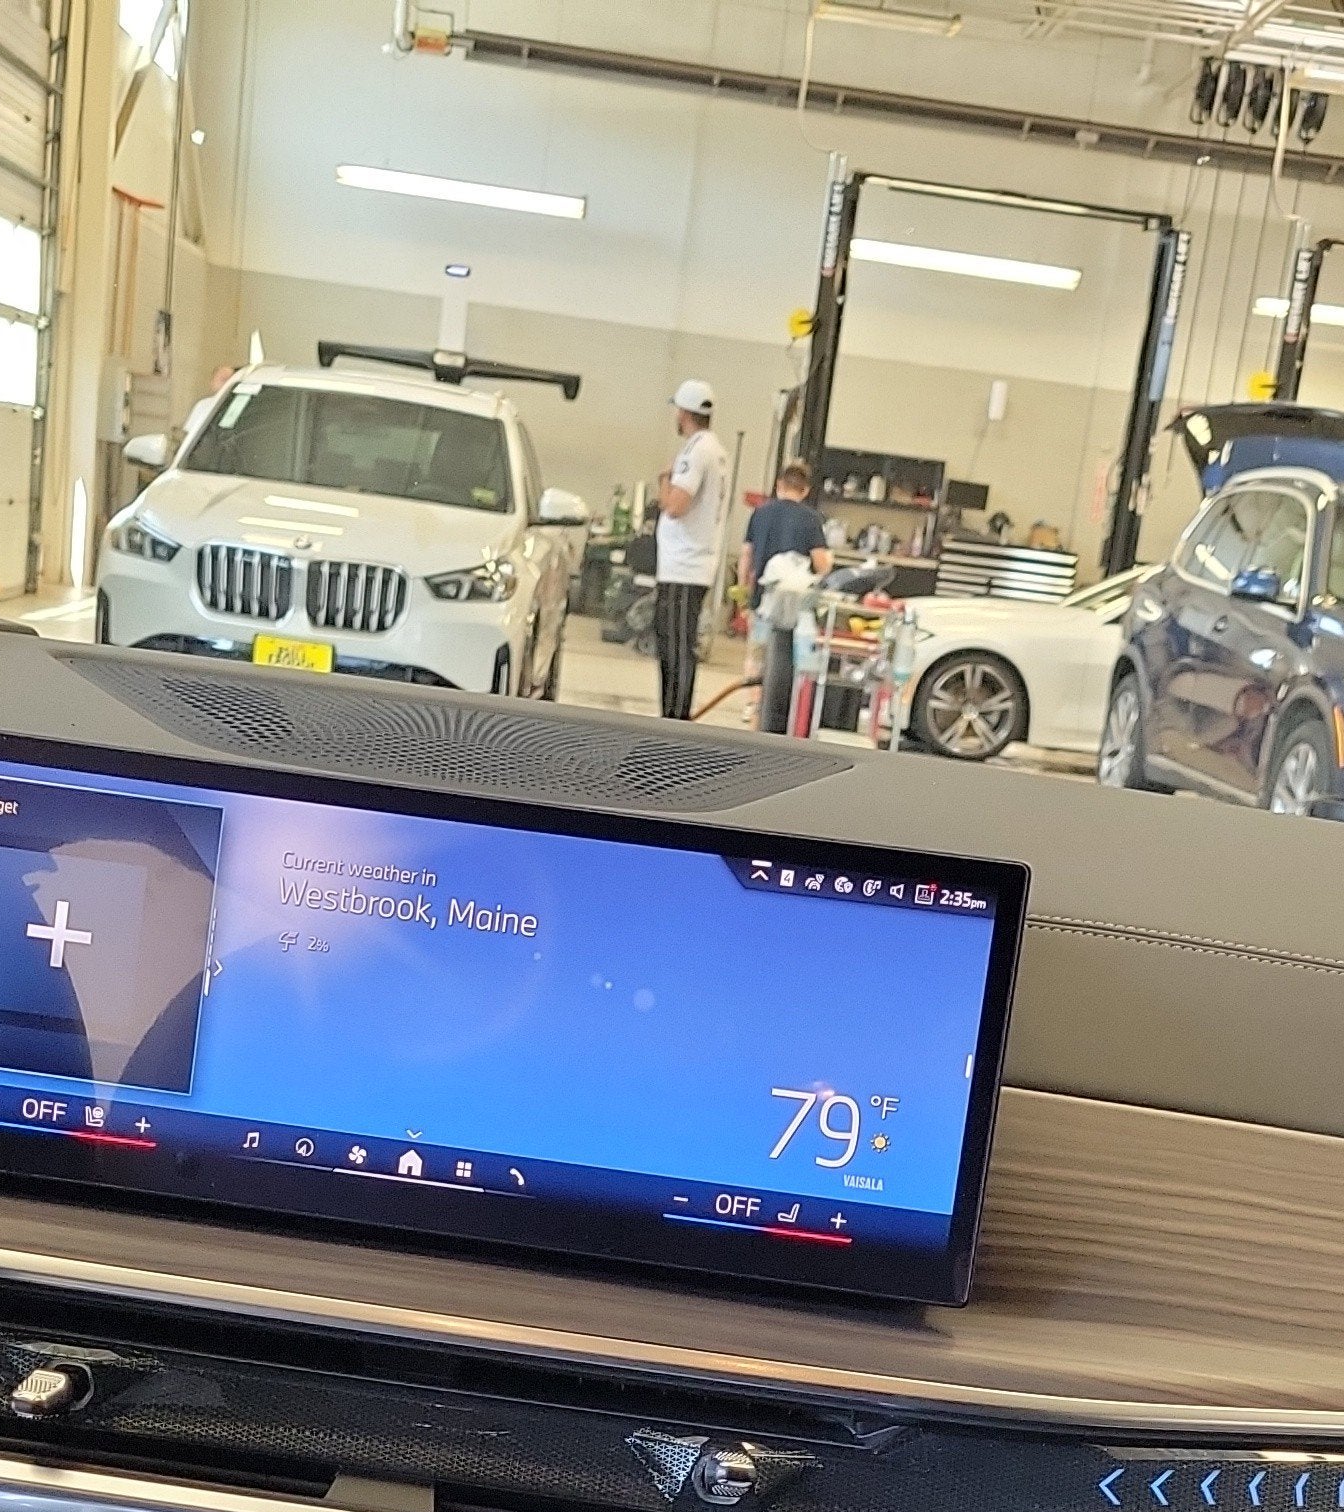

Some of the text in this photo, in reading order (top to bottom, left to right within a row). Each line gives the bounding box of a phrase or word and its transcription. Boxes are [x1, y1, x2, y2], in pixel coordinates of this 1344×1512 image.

[282, 850, 437, 887] Current weather in
[278, 876, 538, 937] Westbrook, Maine
[940, 889, 987, 911] 2:35pm
[308, 936, 330, 952] 2%
[22, 1098, 68, 1123] OFF
[769, 1087, 901, 1169] 79 °F
[843, 1174, 884, 1191] VAISALA
[715, 1193, 762, 1218] OFF
